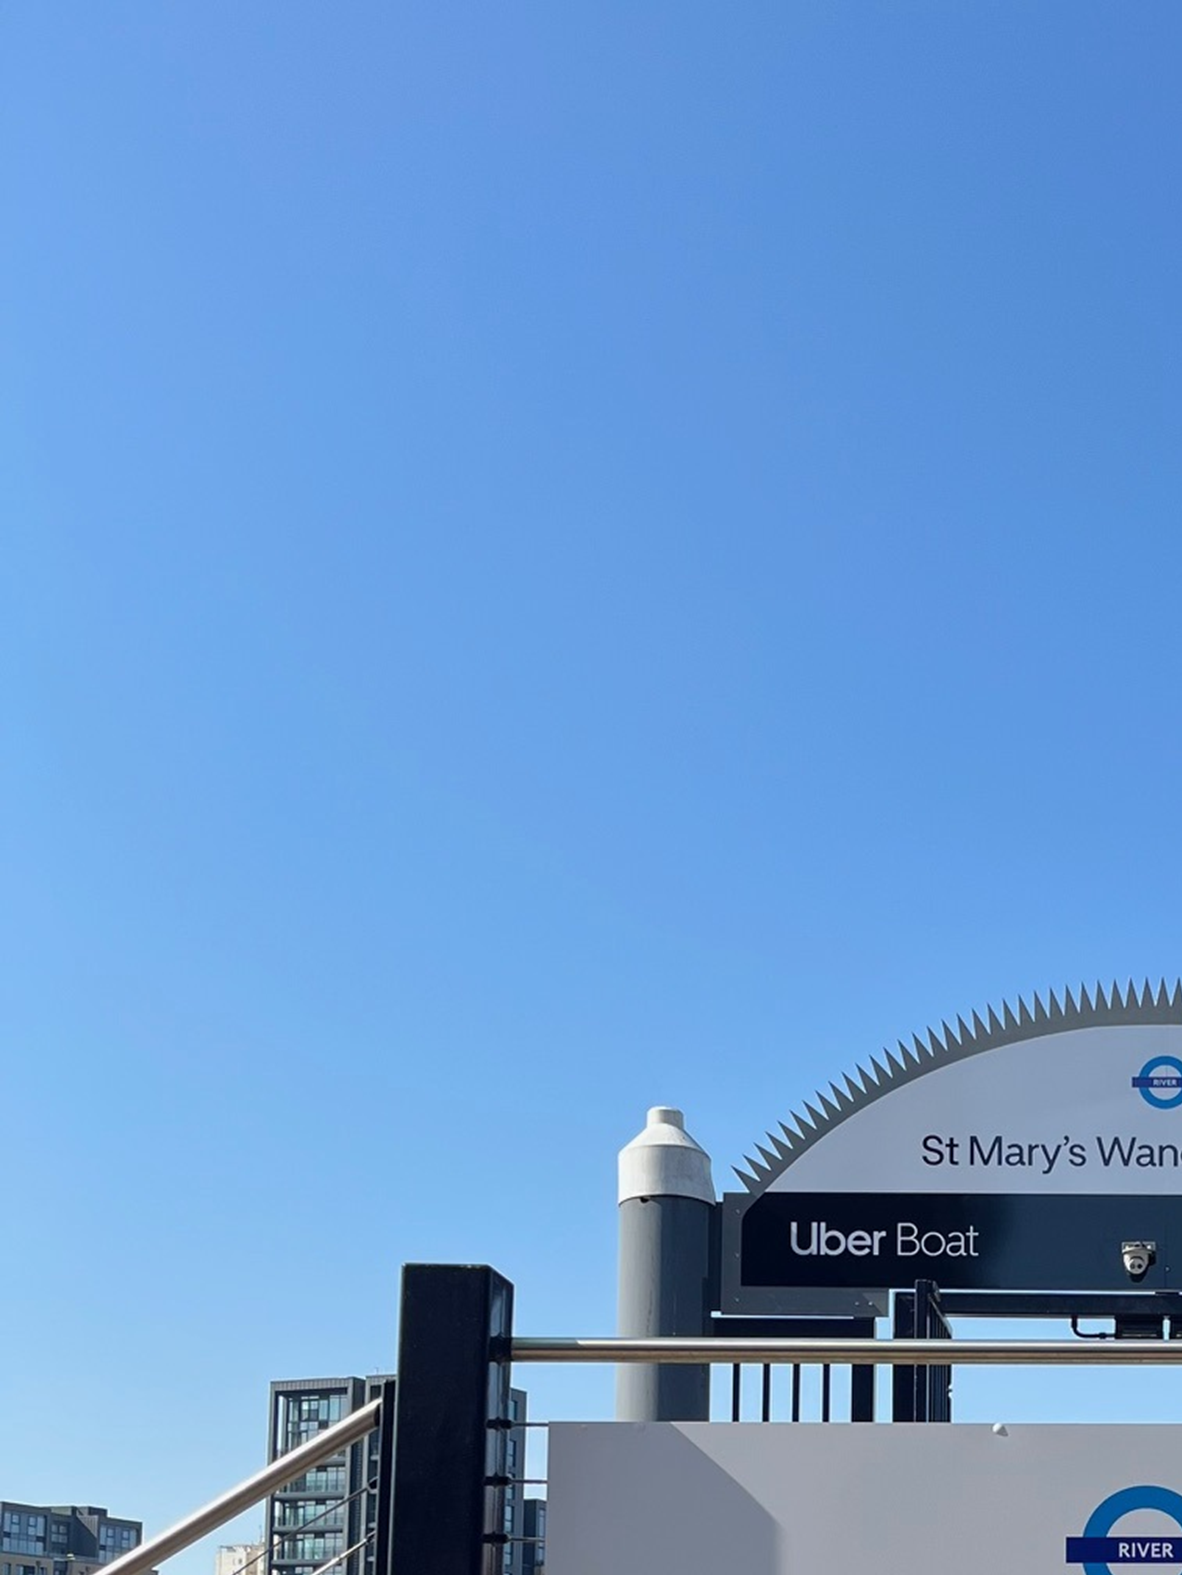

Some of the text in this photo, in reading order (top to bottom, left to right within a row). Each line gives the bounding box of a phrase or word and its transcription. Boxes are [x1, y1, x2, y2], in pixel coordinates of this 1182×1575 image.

[1152, 1078, 1178, 1087] RIVER
[922, 1134, 960, 1166] St
[969, 1135, 1087, 1175] Mary’s
[790, 1221, 980, 1257] Uber Boat
[1118, 1542, 1174, 1559] RIVER
